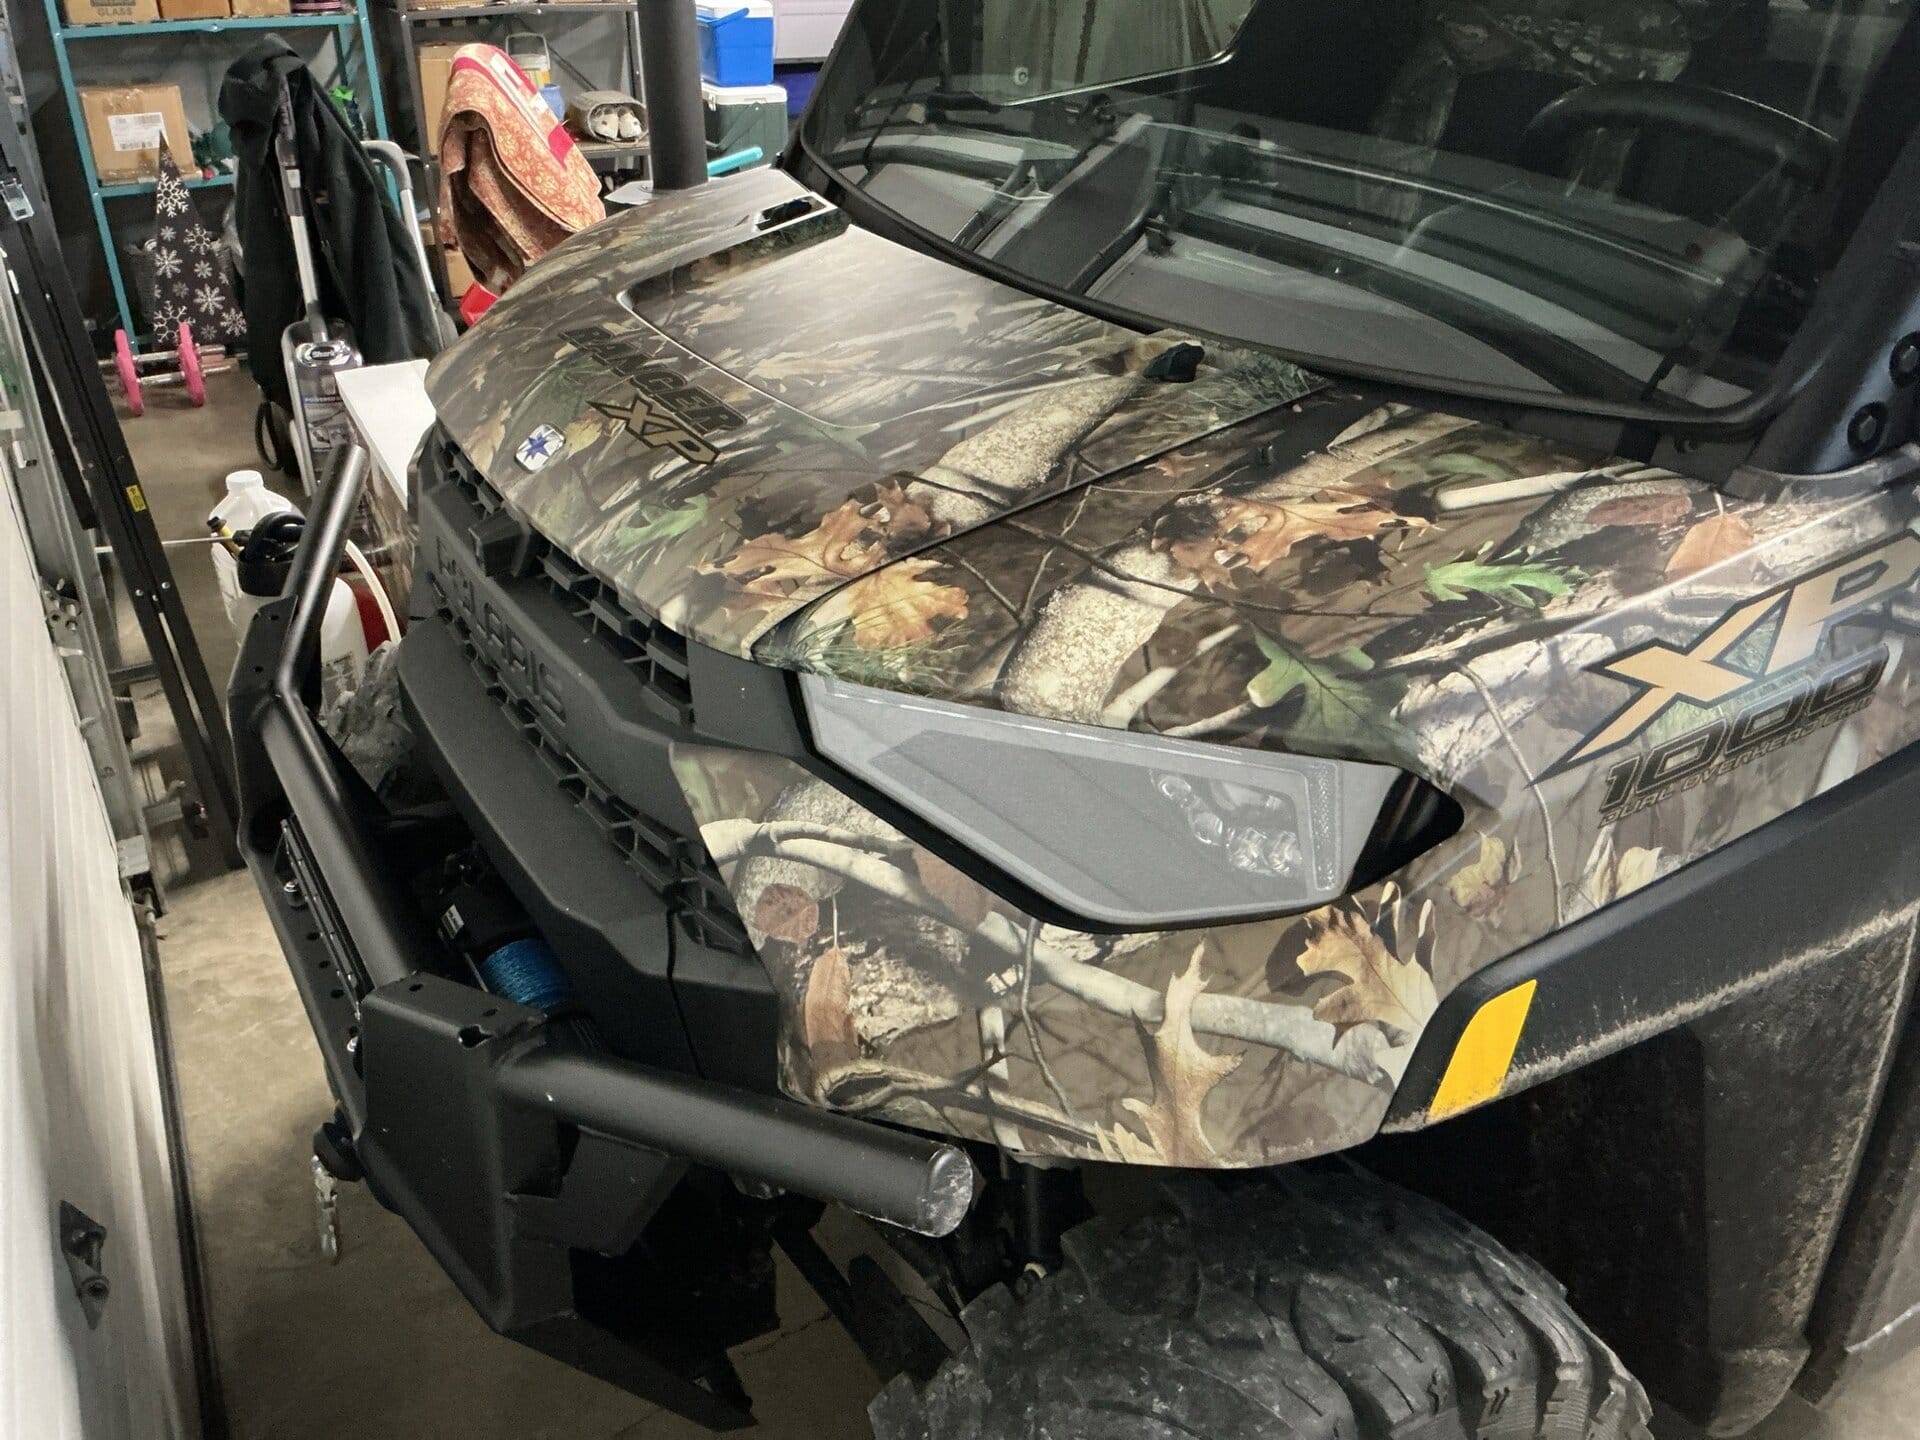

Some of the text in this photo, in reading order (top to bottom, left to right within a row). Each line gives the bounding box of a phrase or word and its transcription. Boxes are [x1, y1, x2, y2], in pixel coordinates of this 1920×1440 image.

[312, 348, 336, 358] Shark
[558, 326, 747, 433] RANGER
[586, 396, 720, 465] XP
[1526, 528, 1920, 787] XP
[1598, 787, 1673, 829] DUAL
[1680, 724, 1817, 789] OVERHEAD
[1599, 643, 1889, 812] 1000
